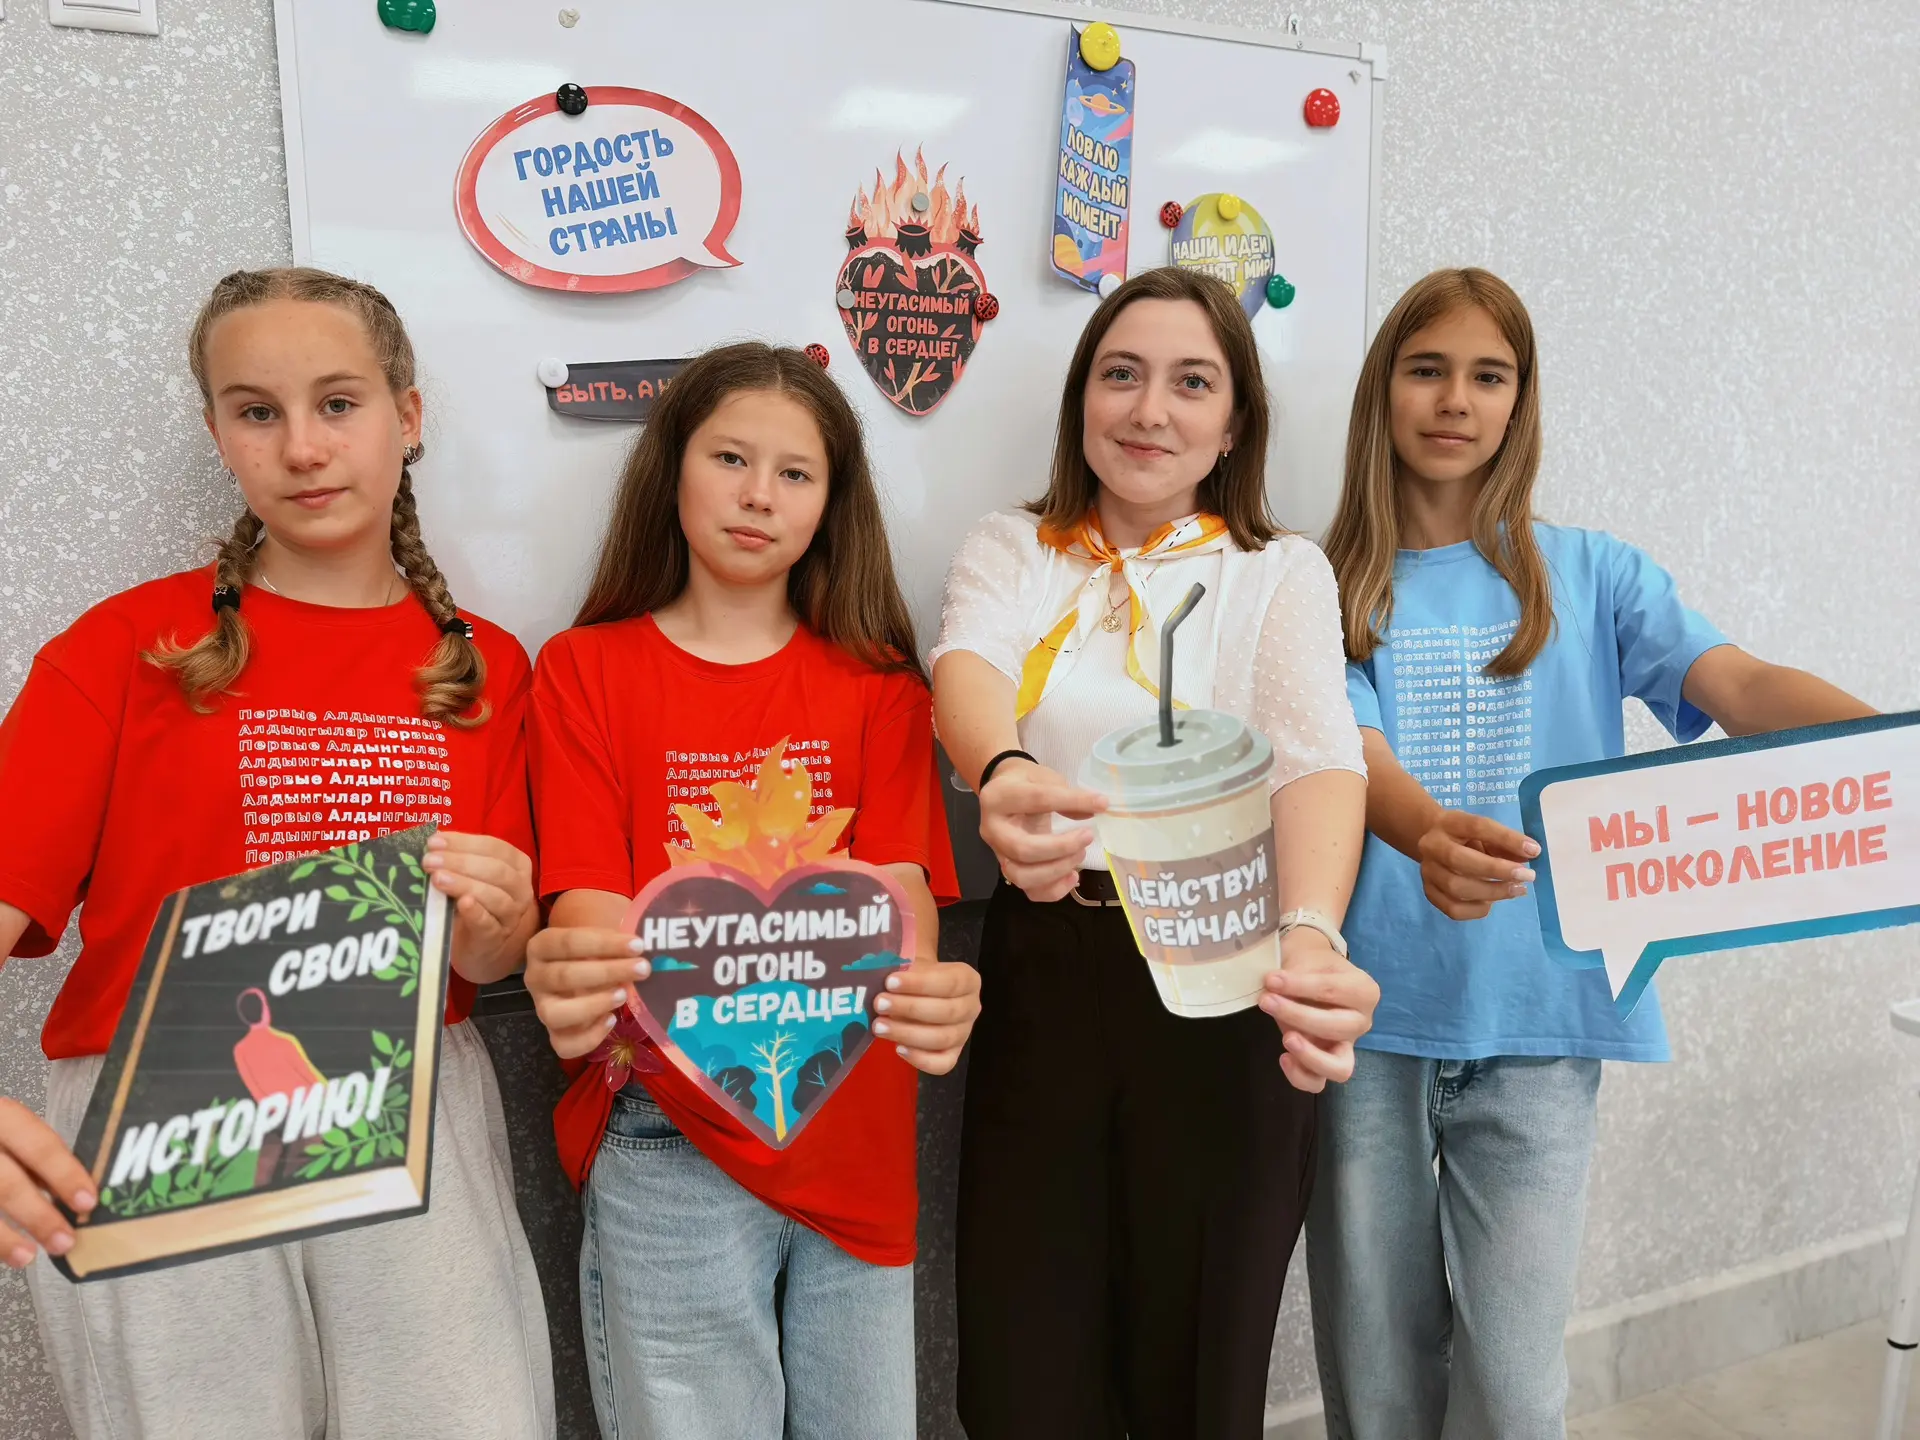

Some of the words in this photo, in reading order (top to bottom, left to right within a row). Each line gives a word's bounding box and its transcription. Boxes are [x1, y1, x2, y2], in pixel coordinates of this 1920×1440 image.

[513, 128, 674, 181] ГОРДОСТЬ
[1066, 124, 1119, 172] ЛОВЛЮ
[541, 161, 660, 218] НАШЕЙ
[1059, 151, 1128, 208] КАЖДЫЙ
[1062, 190, 1121, 239] МОМЕНТ
[549, 206, 678, 256] СТРАНЫ
[1172, 236, 1219, 260] НАШИ
[1223, 235, 1268, 259] ИДЕИ
[1244, 257, 1274, 280] МИР!
[854, 291, 970, 315] НЕУГАСИМЫЙ
[886, 316, 938, 335] ОГОНЬ
[867, 338, 879, 355] В
[885, 338, 958, 360] СЕРДЦЕ!
[556, 381, 634, 403] БЫТЬ,
[637, 379, 654, 399] А
[238, 724, 368, 739] Алдынгылар
[373, 727, 447, 743] Первые
[239, 709, 317, 722] Первые
[323, 711, 443, 730] Алдынгылар
[239, 740, 321, 752] Первые
[326, 740, 449, 758] Алдынгылар
[665, 750, 729, 764] Первые
[238, 756, 372, 769] Алдынгылар
[378, 757, 450, 773] Первые
[240, 772, 323, 788] Первые
[329, 771, 452, 790] Алдынгылар
[667, 784, 709, 798] Перв
[242, 793, 373, 807] Алдынгылар
[379, 791, 452, 807] Первые
[1588, 805, 1671, 853] МЫ
[1736, 770, 1893, 831] НОВОЕ
[244, 811, 323, 826] Первые
[245, 828, 371, 844] Алдынгылар
[1127, 843, 1268, 909] ДЕЙСТВУЙ
[1605, 824, 1888, 901] ПОКОЛЕНИЕ
[180, 889, 322, 959] ТВОРИ
[642, 894, 891, 950] НЕУГАСИМЫЙ
[1144, 896, 1266, 947] СЕЙЧАС!
[268, 927, 399, 997] СВОЮ
[713, 950, 826, 986] ОГОНЬ
[675, 997, 699, 1029] В
[712, 986, 867, 1026] СЕРДЦЕ!
[108, 1067, 390, 1187] ИСТОРИЮ!
